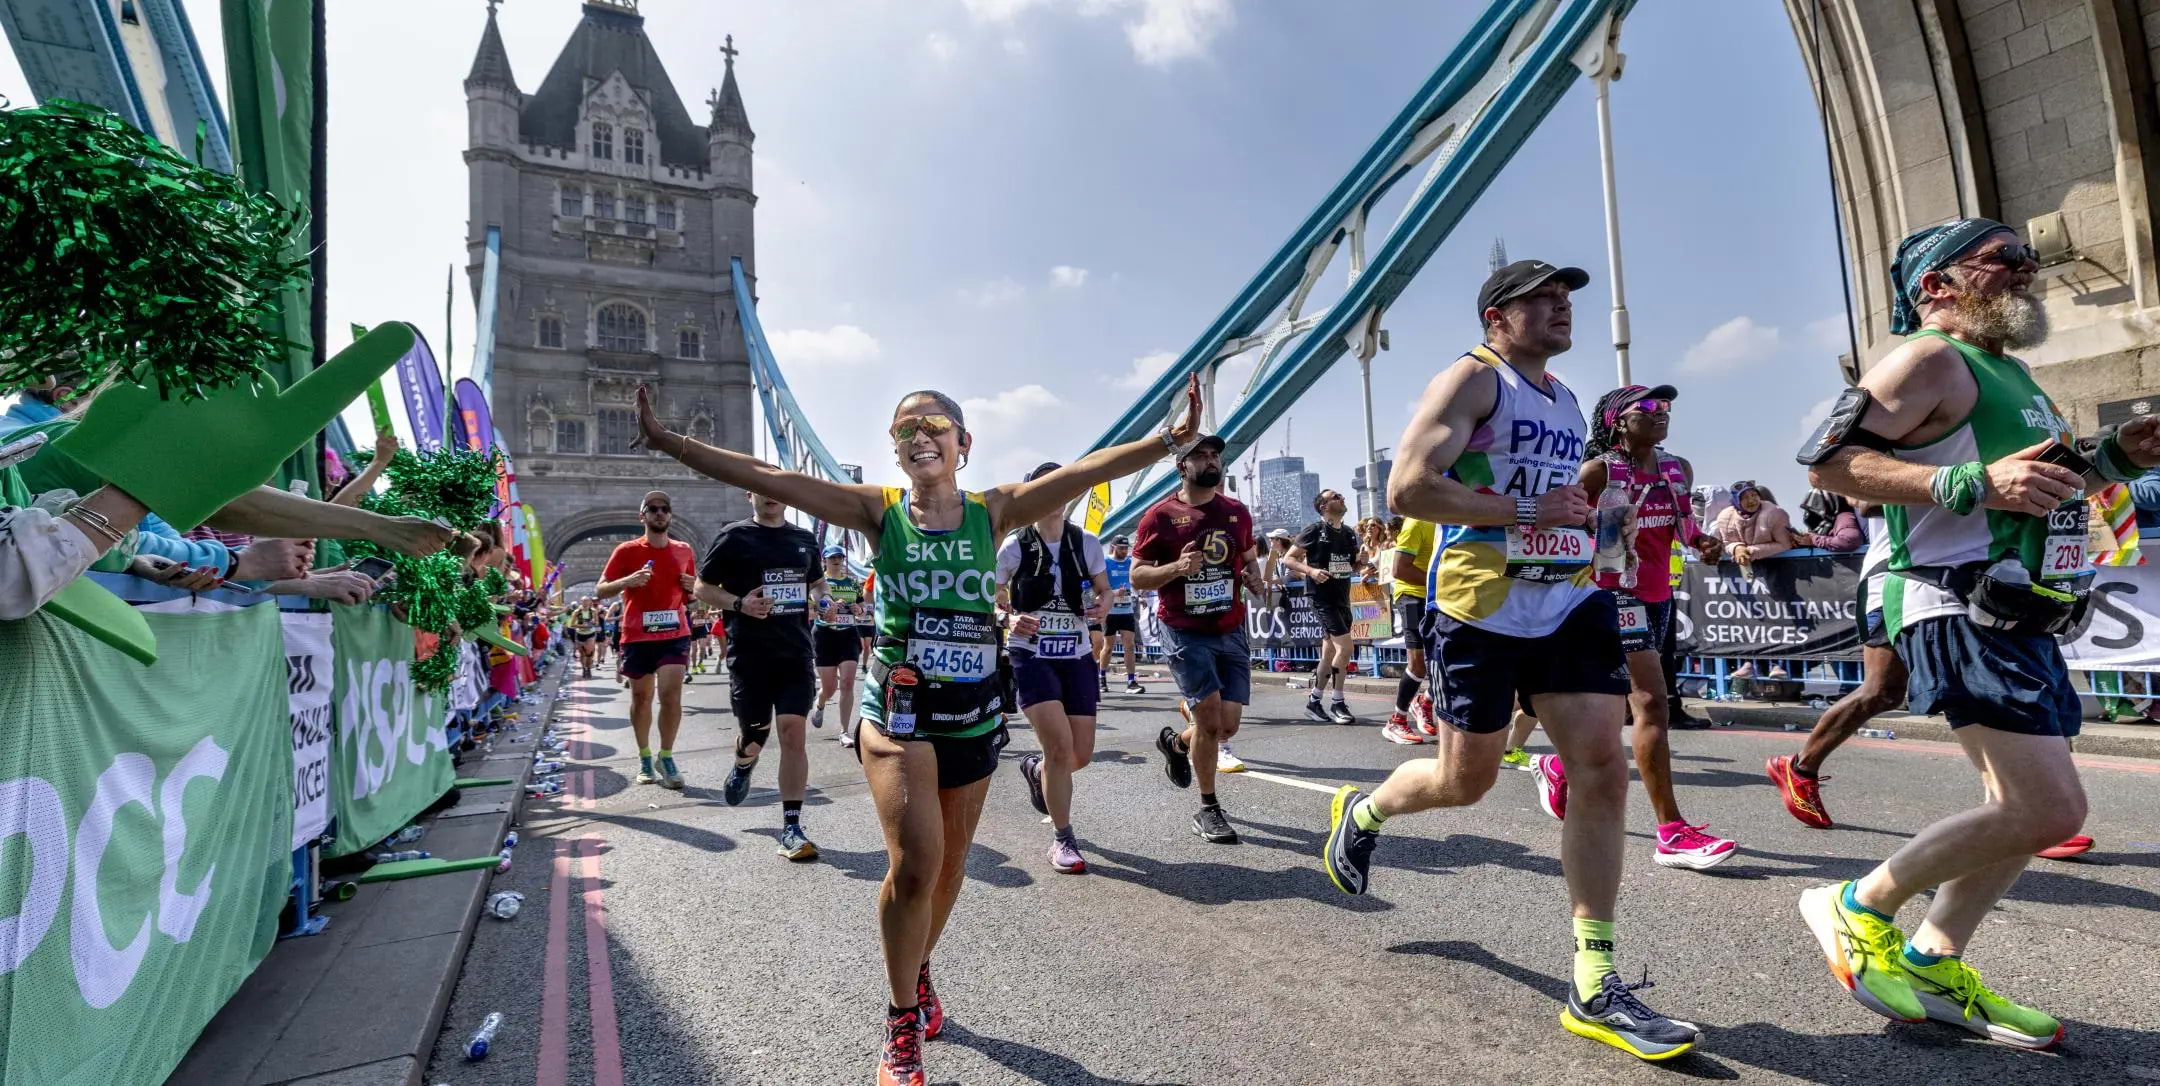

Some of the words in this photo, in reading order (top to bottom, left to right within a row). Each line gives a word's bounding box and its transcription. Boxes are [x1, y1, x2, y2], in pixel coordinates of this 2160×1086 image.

[1637, 515, 1676, 529] ANDREA
[2050, 509, 2077, 530] tcs
[905, 540, 974, 562] SKYE
[1203, 530, 1229, 565] 45
[1523, 534, 1581, 556] 30249
[771, 586, 802, 600] 57541
[883, 569, 996, 604] NSPCC
[1193, 583, 1226, 600] 59459
[1704, 577, 1770, 595] TATA
[649, 612, 674, 622] 72077
[1247, 600, 1286, 639] tcs
[1705, 600, 1856, 620] CONSULTANC
[915, 611, 949, 636] tcs
[954, 615, 974, 623] TATA
[952, 630, 981, 639] SERVICES
[1705, 624, 1808, 645] SERVICES
[1042, 639, 1074, 654] TIFF
[921, 647, 984, 674] 54564
[889, 720, 914, 730] UXTON
[931, 712, 954, 721] LONDON
